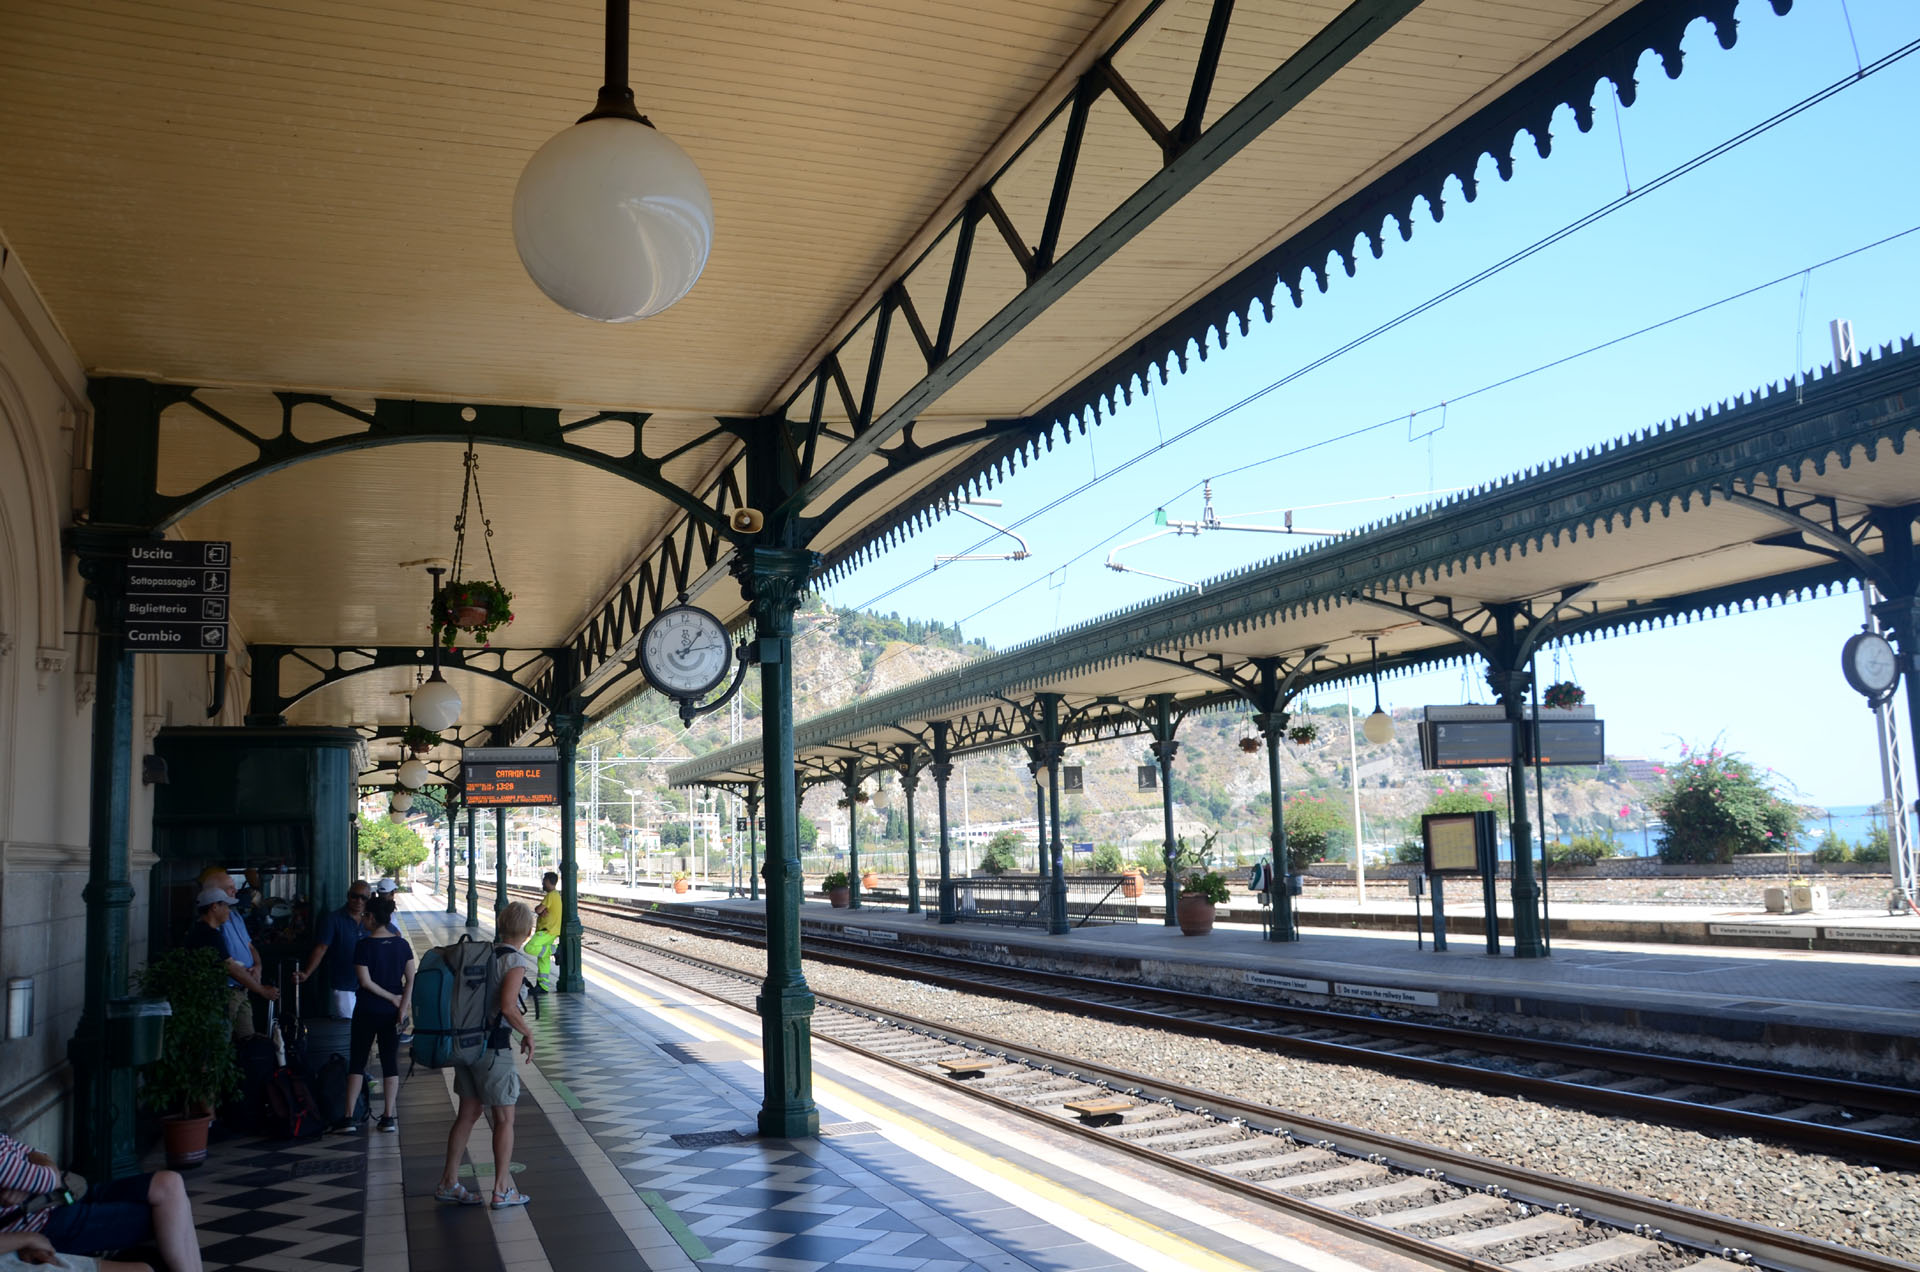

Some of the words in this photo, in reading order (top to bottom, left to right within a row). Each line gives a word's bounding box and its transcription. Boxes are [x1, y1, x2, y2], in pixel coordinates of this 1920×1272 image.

[131, 547, 173, 559] Uscita
[130, 575, 196, 588] Sottopassaggio
[129, 603, 187, 615] Biglietteria
[681, 614, 690, 623] 12
[128, 629, 181, 642] Cambio
[653, 630, 663, 638] 10
[711, 630, 718, 639] 2
[649, 647, 657, 656] 9
[1438, 727, 1446, 737] 2
[1594, 725, 1600, 735] 3
[467, 768, 473, 778] 1
[496, 769, 524, 778] CATANIA
[740, 822, 745, 830] 2
[1383, 992, 1401, 1000] railway
